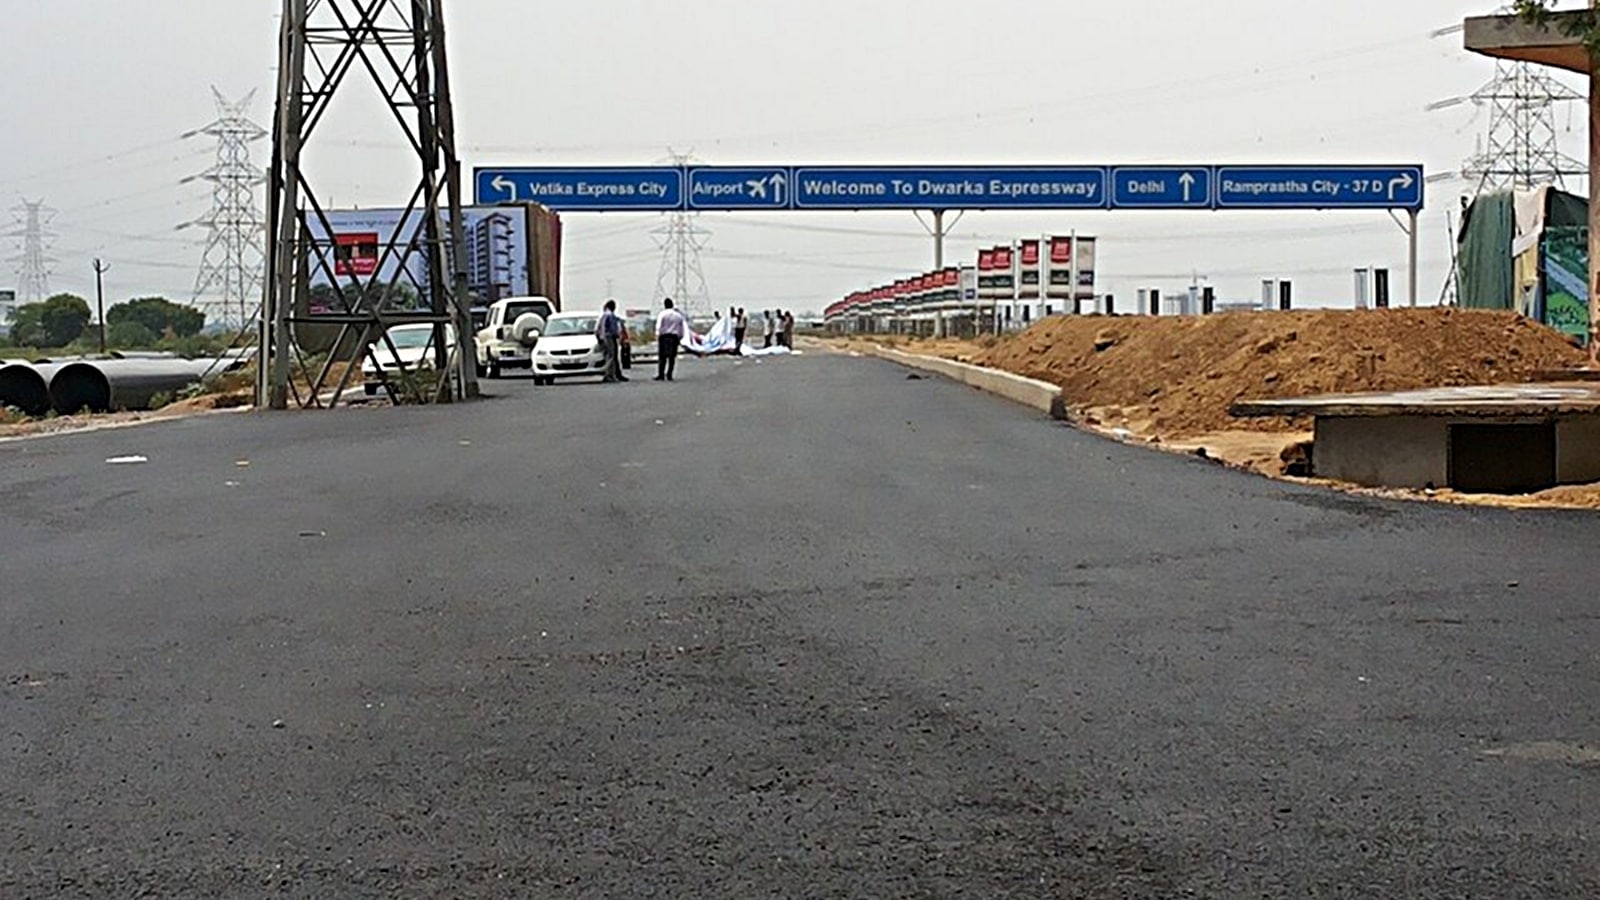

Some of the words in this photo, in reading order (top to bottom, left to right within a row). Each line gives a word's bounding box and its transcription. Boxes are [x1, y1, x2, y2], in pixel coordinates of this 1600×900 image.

[529, 182, 573, 195] Vatika
[576, 182, 635, 197] Express
[639, 182, 667, 197] City
[693, 182, 743, 197] Airport
[804, 180, 885, 195] Welcome
[891, 180, 913, 195] To
[918, 180, 984, 195] Dwarka
[990, 180, 1096, 197] Expressway
[1128, 180, 1165, 193] Delhi
[1223, 180, 1308, 195] Ramprastha
[1312, 180, 1340, 195] City
[1352, 180, 1369, 193] 37
[1372, 180, 1383, 193] D
